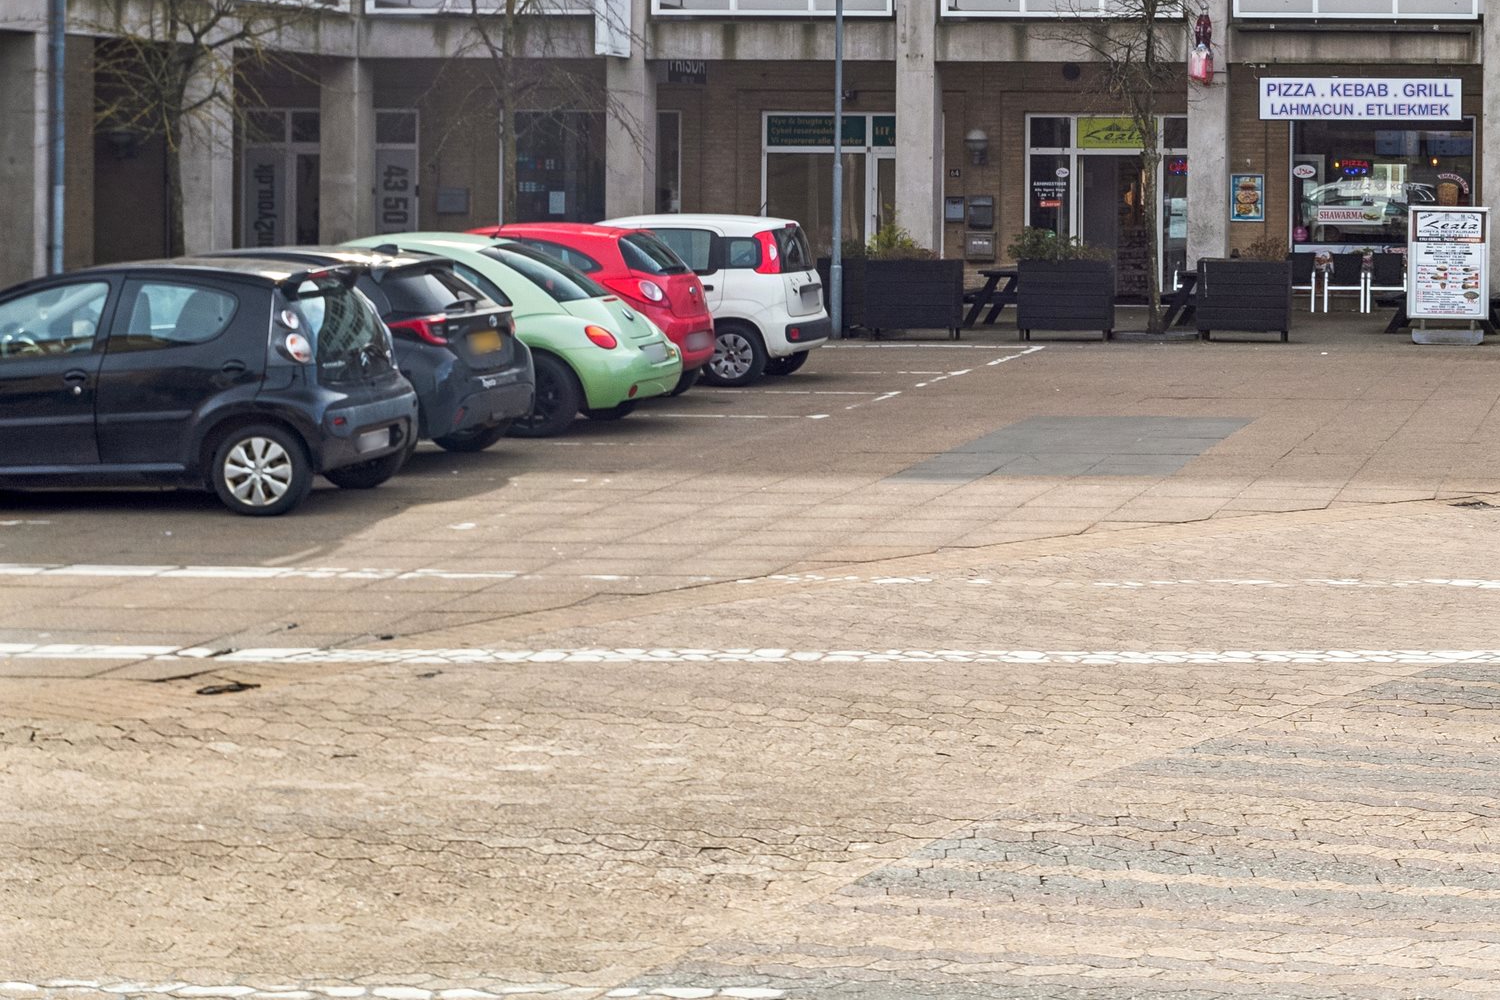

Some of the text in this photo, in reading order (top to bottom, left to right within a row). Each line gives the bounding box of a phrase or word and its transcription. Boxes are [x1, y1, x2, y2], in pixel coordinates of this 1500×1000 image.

[1266, 83, 1316, 98] PIZZA
[1330, 83, 1389, 98] KEBAB
[1402, 83, 1454, 98] GRILL
[1270, 103, 1354, 116] LAHMACUN
[1366, 103, 1450, 116] ETLIEKMEK
[1341, 159, 1369, 167] PIZZA
[382, 165, 409, 225] 43 50
[1319, 210, 1363, 220] SHAWARMA
